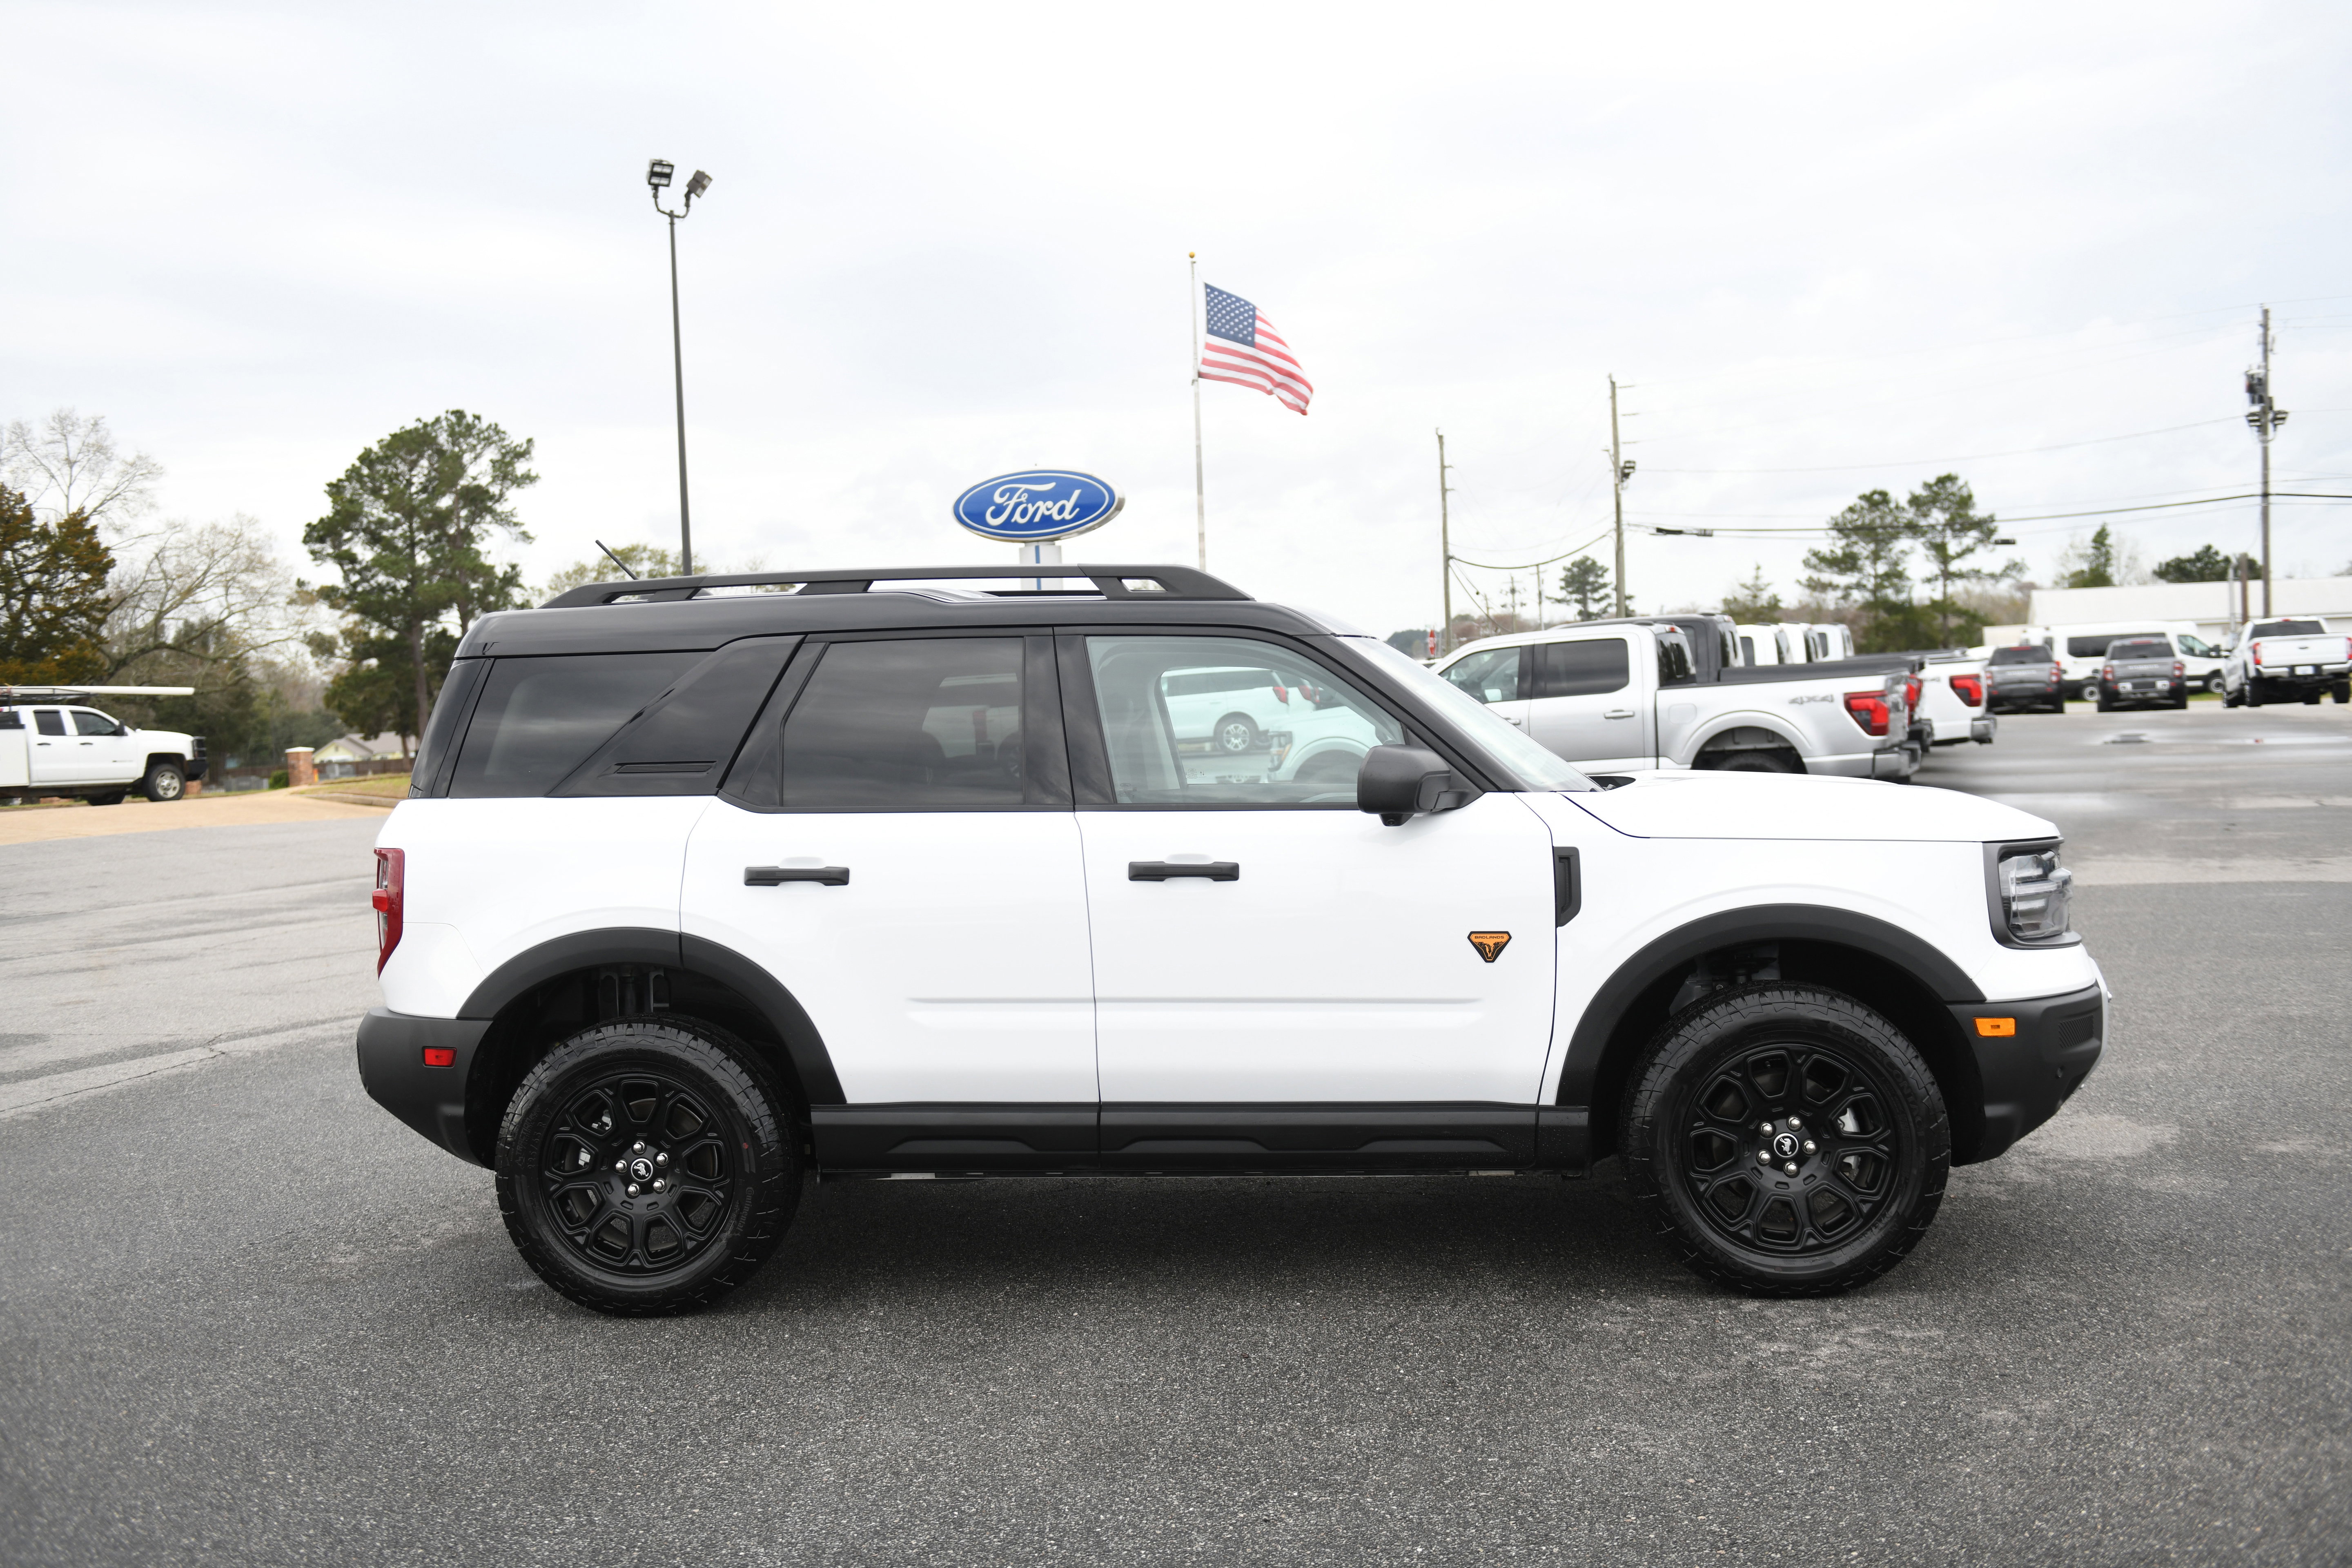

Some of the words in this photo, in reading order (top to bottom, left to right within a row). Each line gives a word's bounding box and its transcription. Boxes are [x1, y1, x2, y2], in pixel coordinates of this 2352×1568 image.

[985, 482, 1082, 526] Ford
[737, 1187, 755, 1232] Continental
[1655, 1158, 1758, 1277] CONTINENTAL
